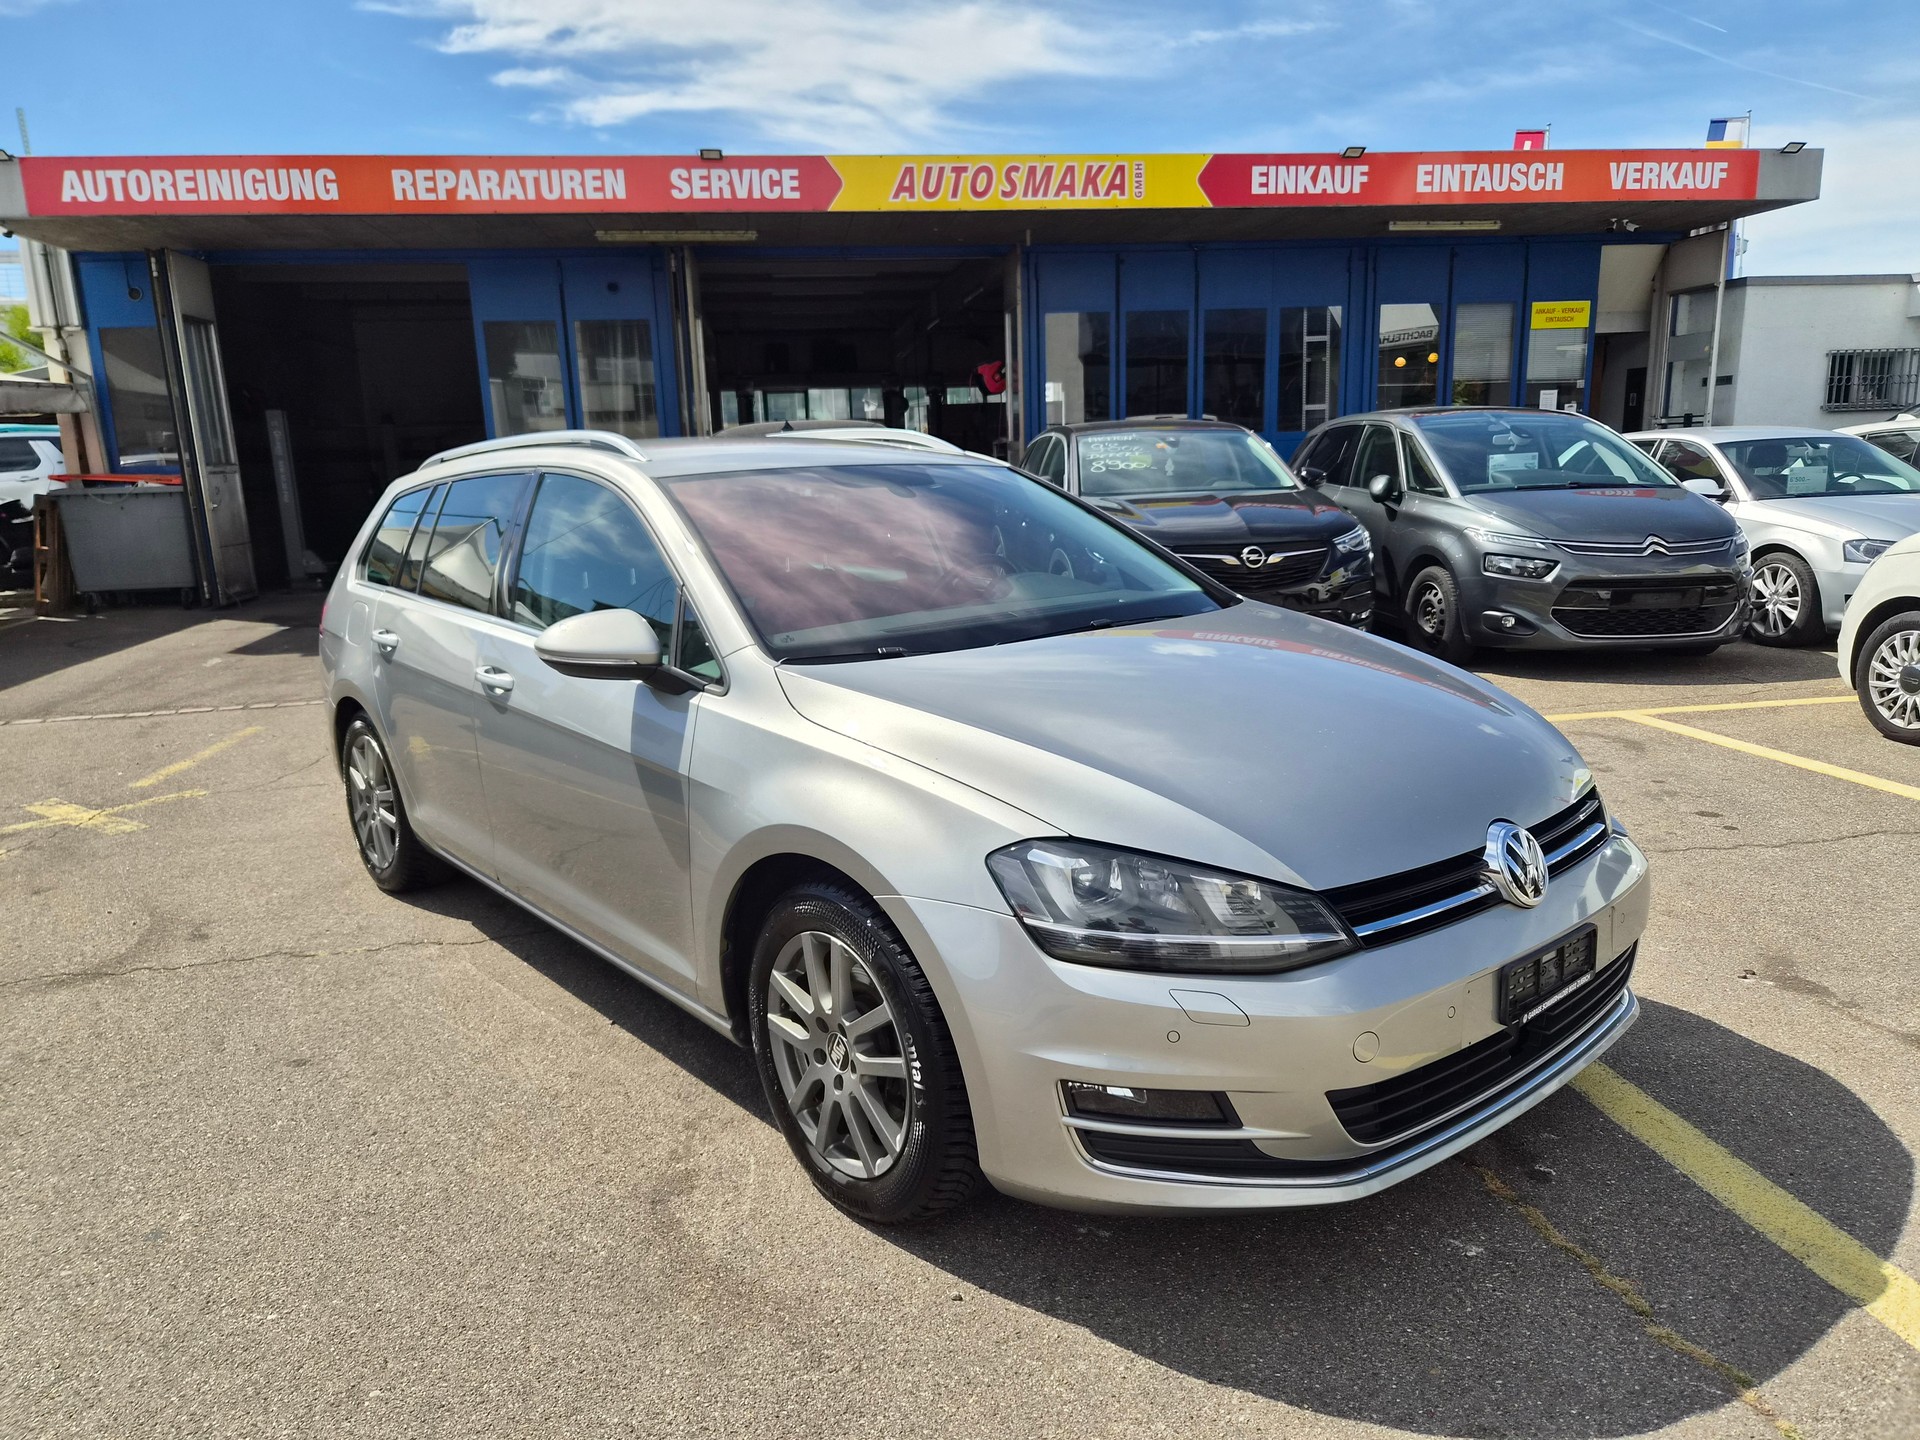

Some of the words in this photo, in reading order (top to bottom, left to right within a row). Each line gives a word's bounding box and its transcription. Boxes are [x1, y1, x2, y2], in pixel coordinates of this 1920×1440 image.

[61, 168, 339, 203] AUTOREINIGUNG
[391, 168, 627, 201] REPARATUREN
[669, 167, 801, 200] SERVICE
[891, 163, 997, 201] AUTO
[1000, 162, 1128, 200] SMAKA
[1133, 162, 1144, 199] GMBH
[1251, 165, 1369, 195] EINKAUF
[1416, 162, 1564, 193] EINTAUSCH
[1609, 161, 1729, 190] VERKAUF
